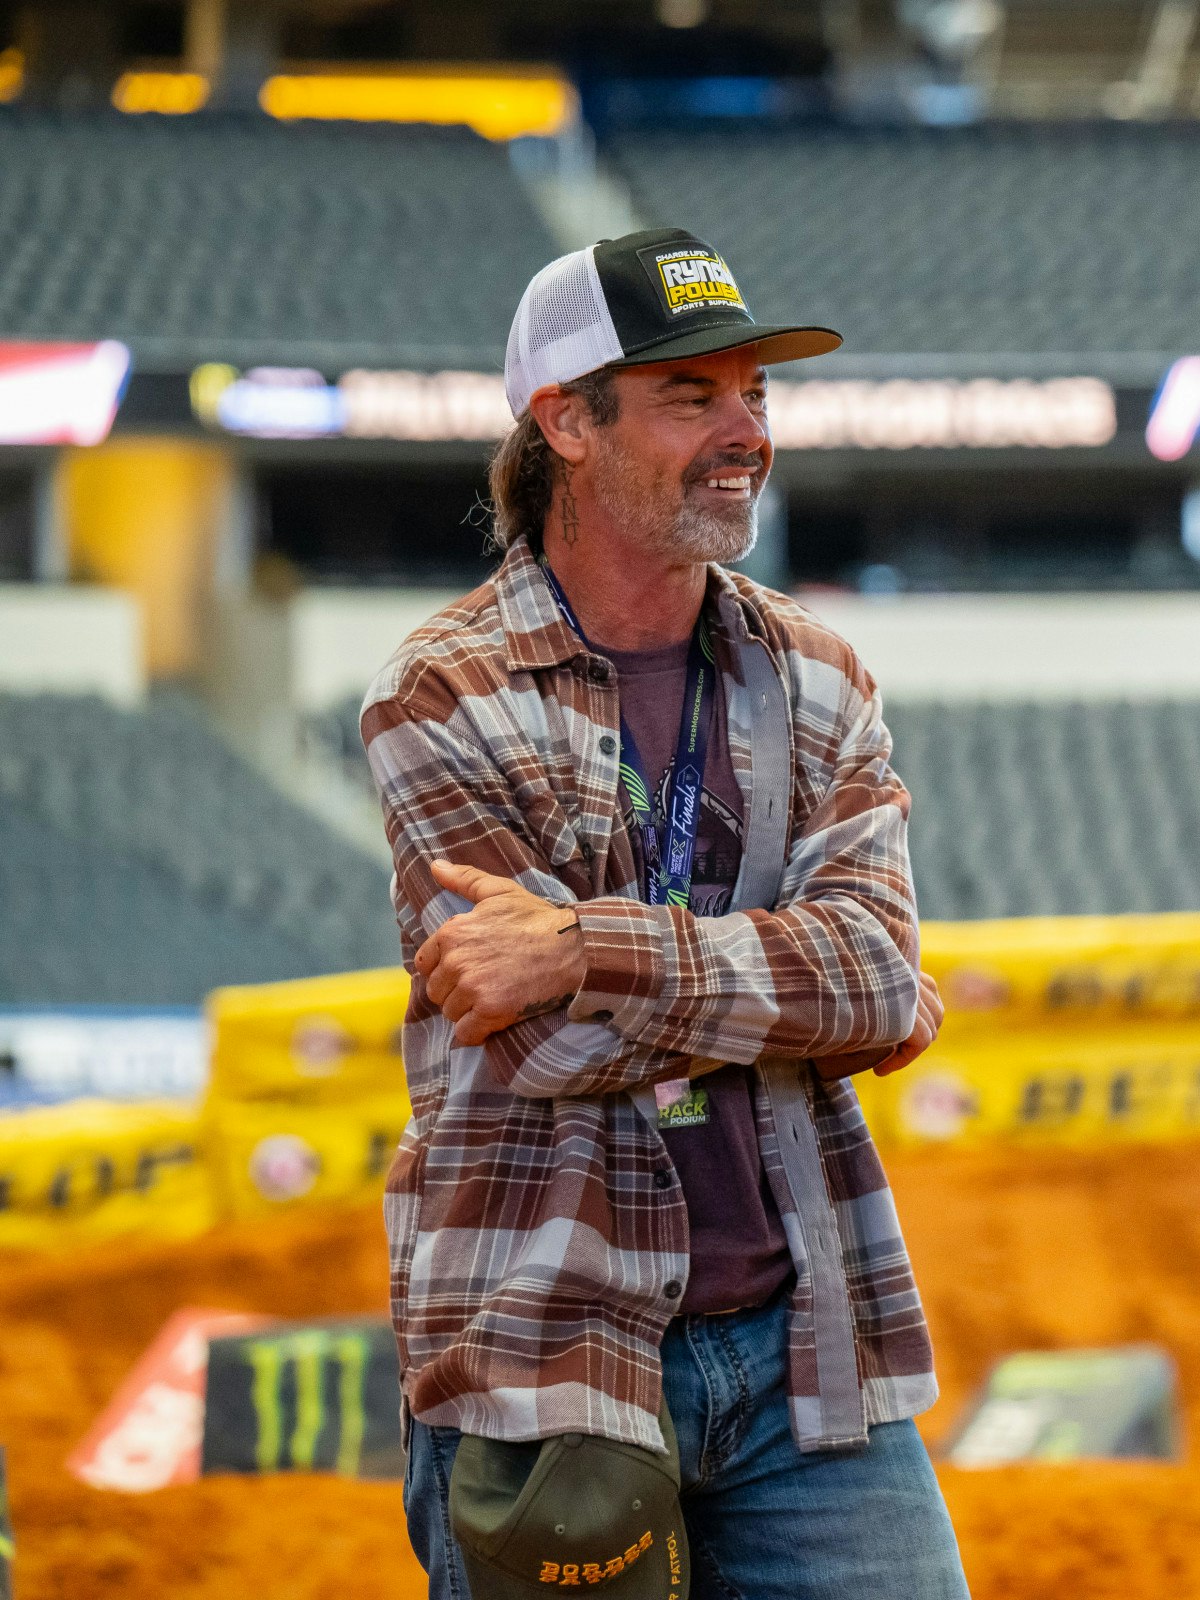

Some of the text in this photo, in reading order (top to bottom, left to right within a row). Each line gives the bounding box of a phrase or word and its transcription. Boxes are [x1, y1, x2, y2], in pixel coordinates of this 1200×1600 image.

[671, 784, 697, 838] Finals
[659, 1102, 705, 1119] RACK
[670, 1114, 706, 1125] PODIUM
[665, 1530, 681, 1586] PATROL
